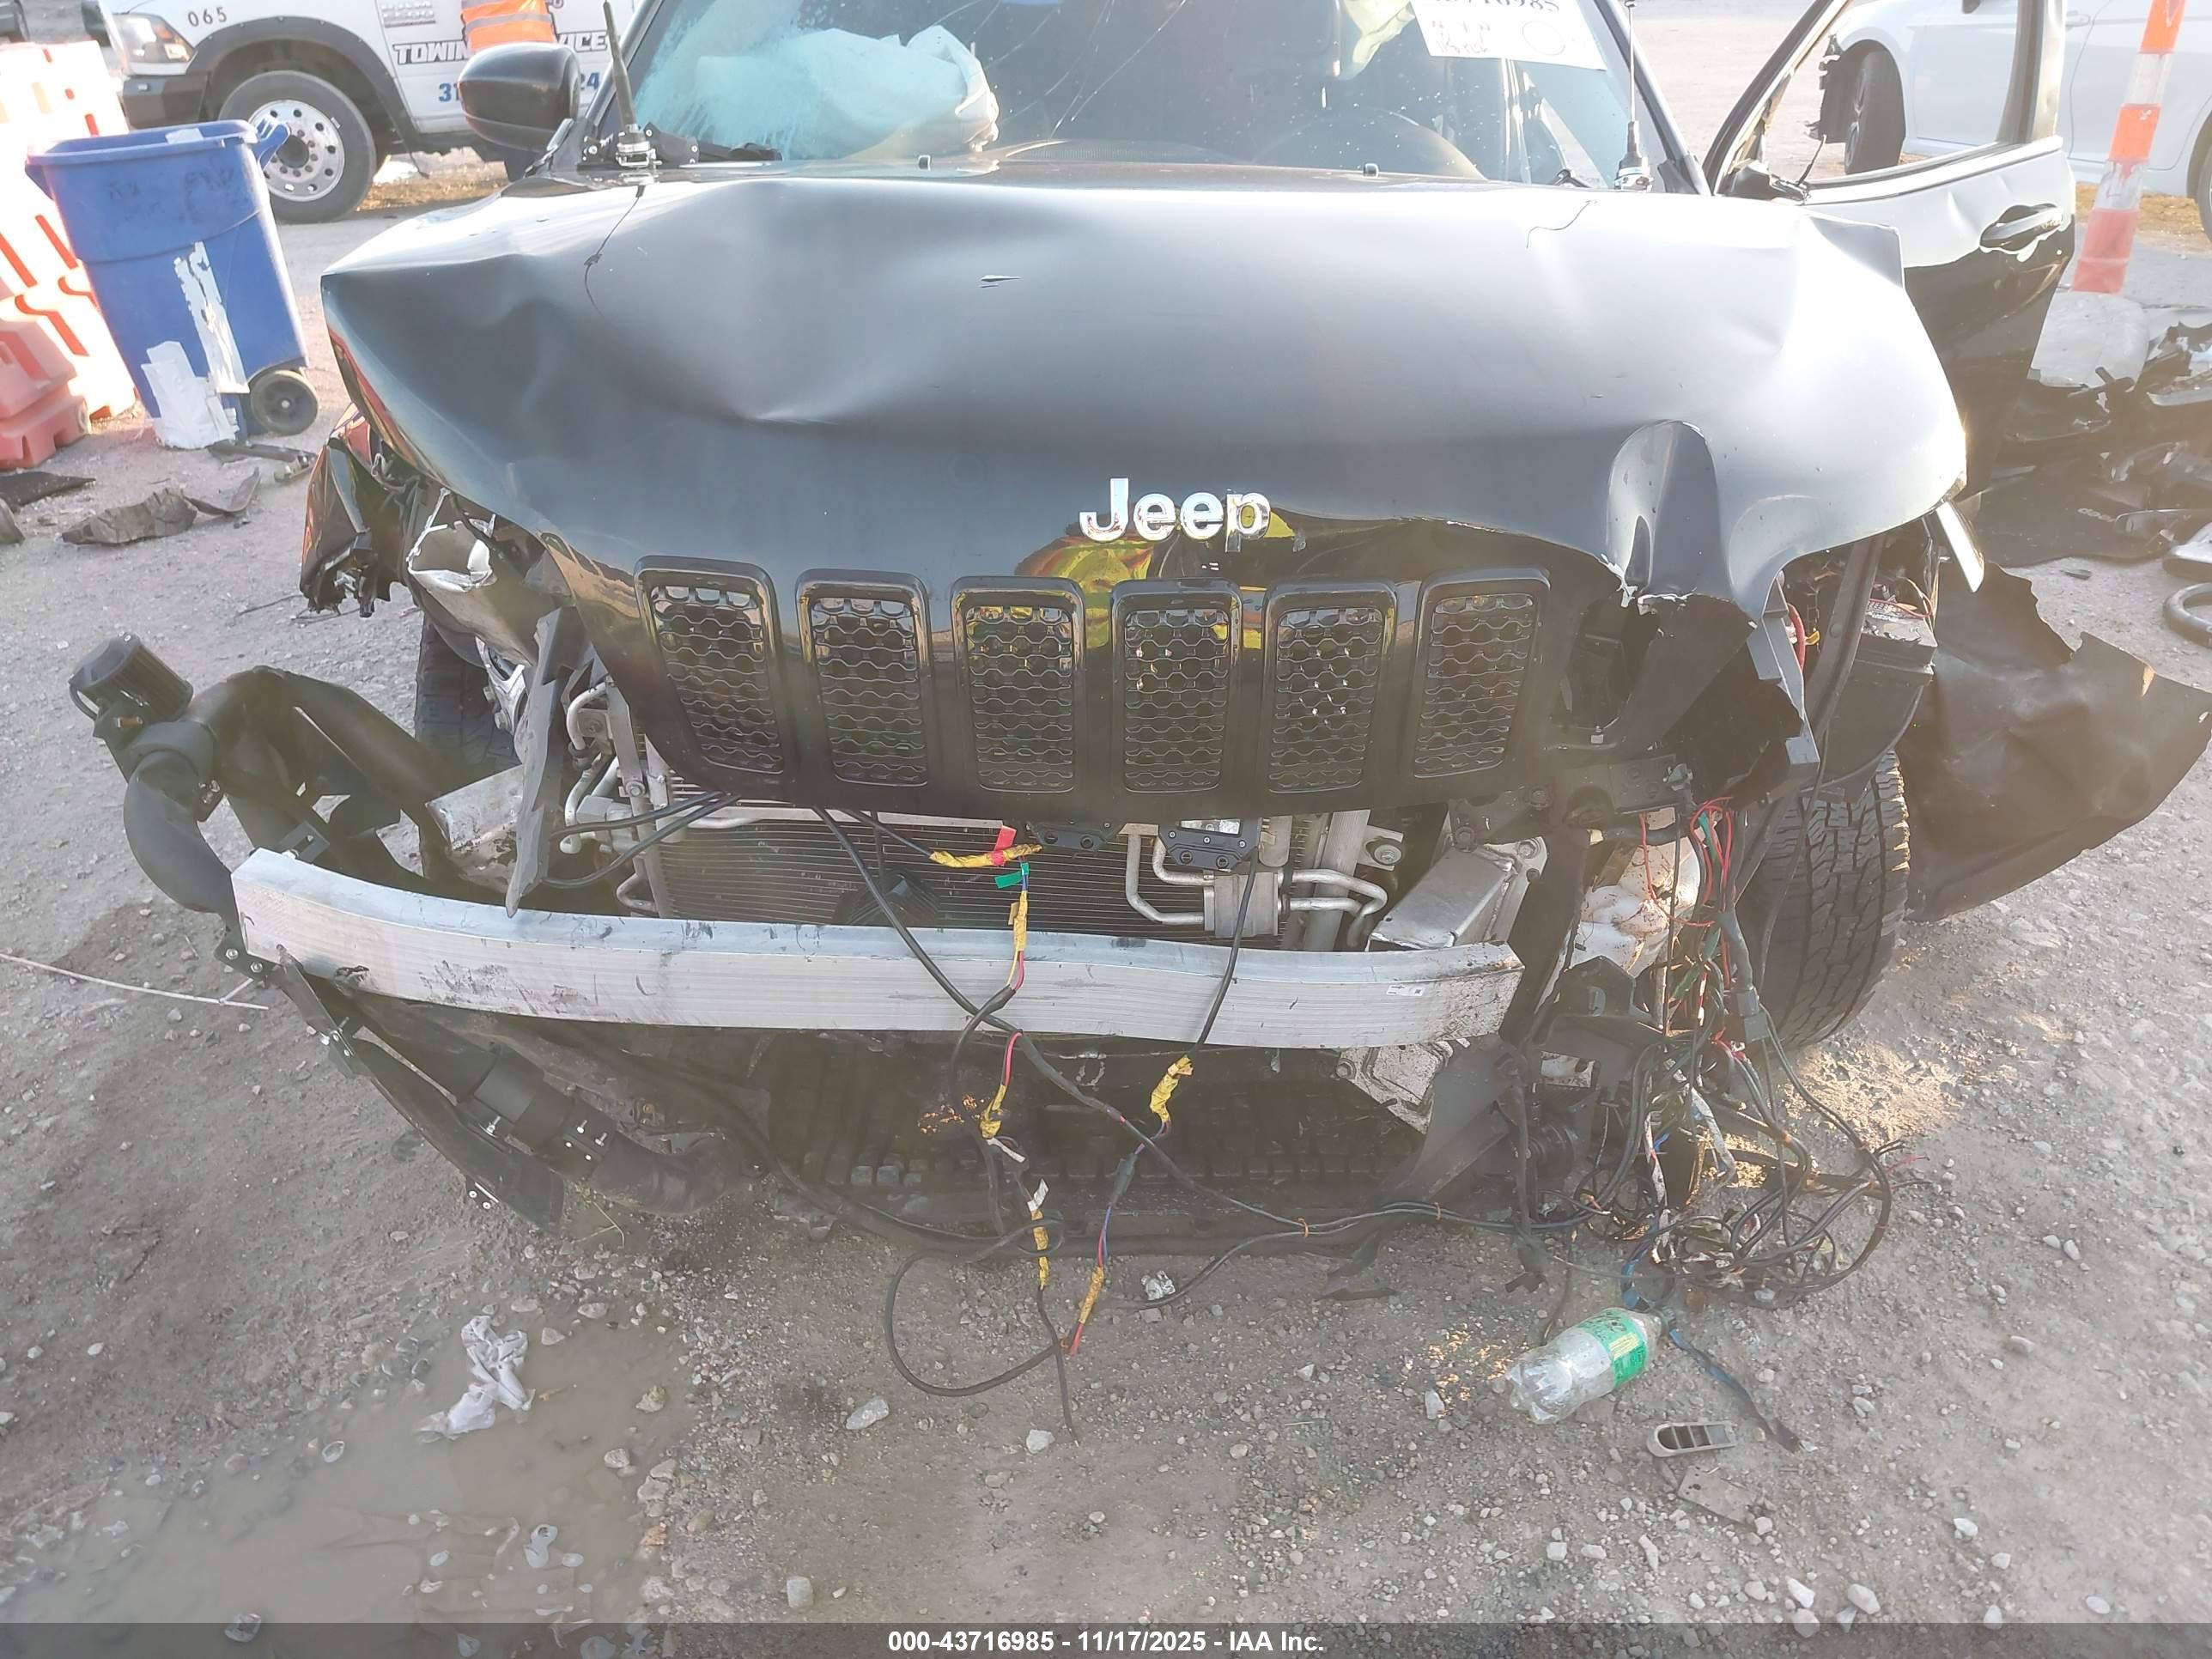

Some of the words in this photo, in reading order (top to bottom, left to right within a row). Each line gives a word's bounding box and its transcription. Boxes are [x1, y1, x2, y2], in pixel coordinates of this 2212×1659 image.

[187, 6, 228, 27] 065
[392, 39, 469, 65] TOWIN
[1079, 477, 1272, 552] Jeep
